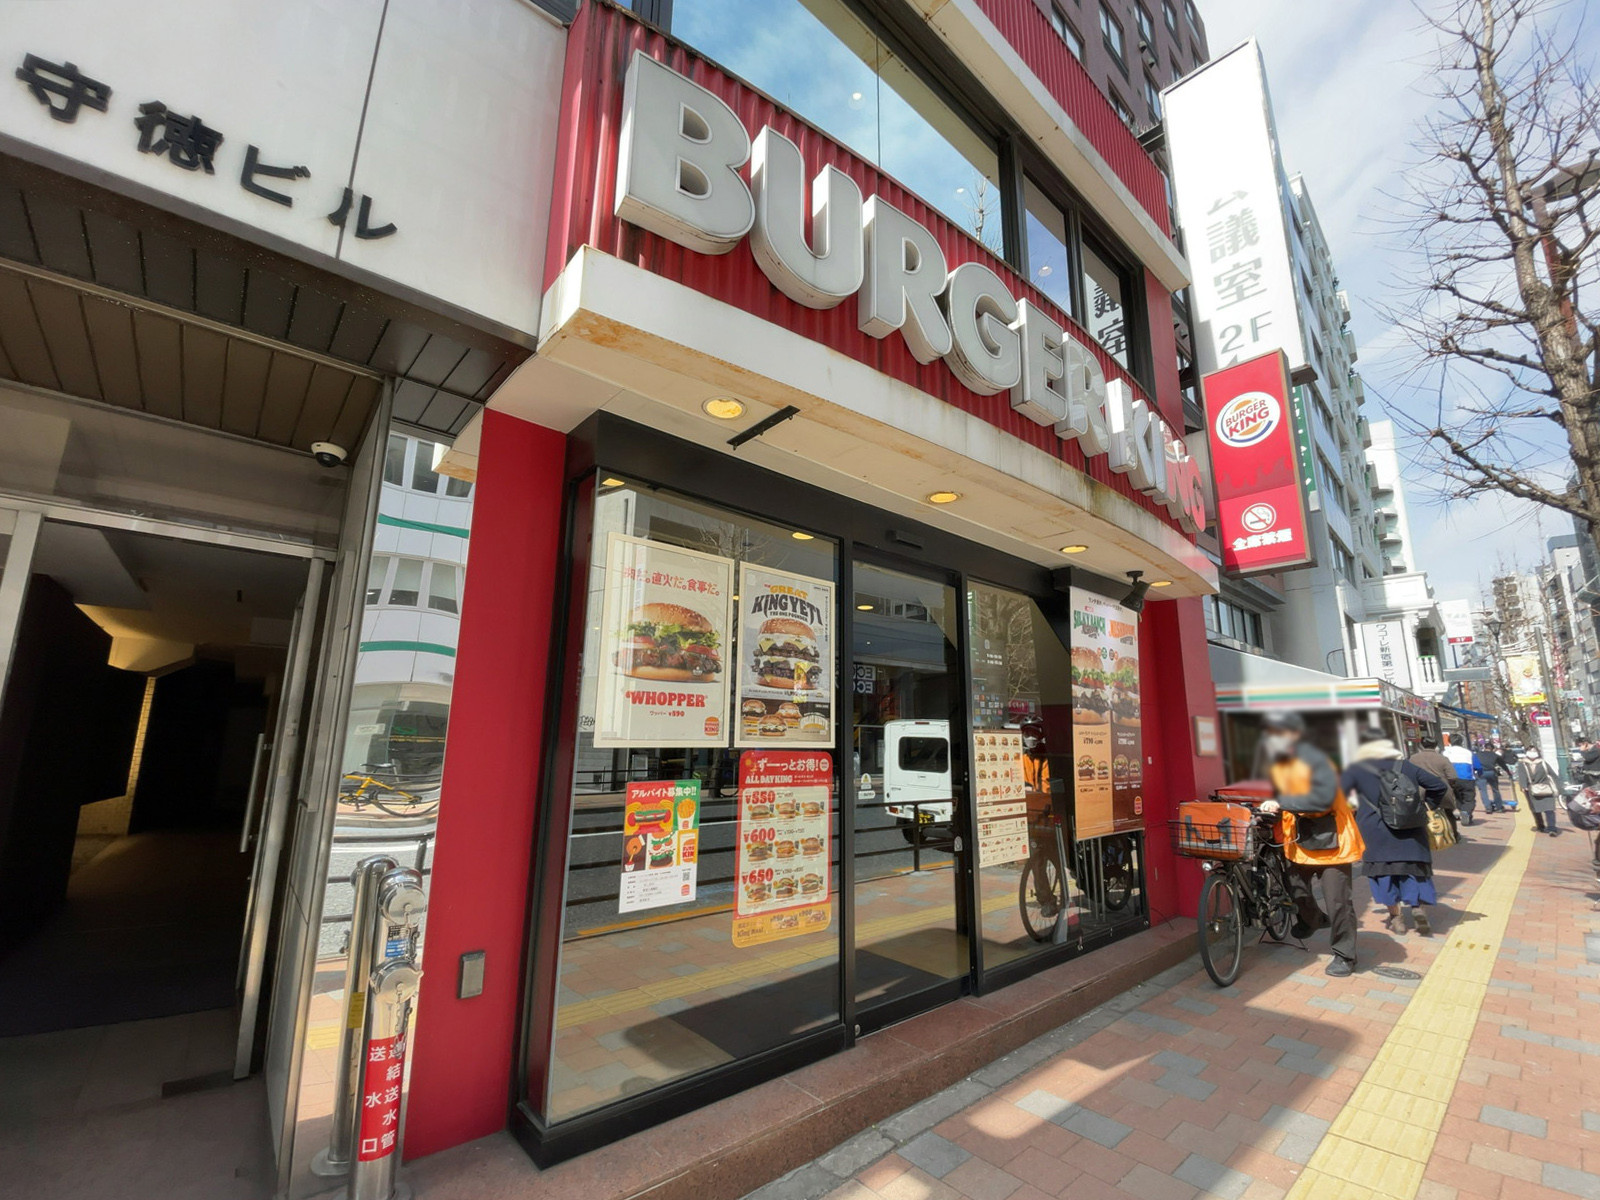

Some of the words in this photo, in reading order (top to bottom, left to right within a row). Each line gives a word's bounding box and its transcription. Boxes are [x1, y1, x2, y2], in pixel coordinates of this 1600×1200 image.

[15, 52, 398, 240] 守徳ビル
[615, 49, 1111, 458] BURGER
[1106, 377, 1206, 533] KING
[1219, 311, 1273, 355] 2F
[1225, 400, 1266, 428] BURGER
[1228, 407, 1270, 439] KING
[770, 585, 808, 599] GREAT
[751, 594, 788, 618] KING
[789, 596, 823, 625] YETI
[625, 690, 706, 707] WHOPPER
[745, 775, 760, 784] ALL
[760, 775, 775, 784] DAY
[775, 775, 792, 783] KING
[745, 790, 776, 804] ¥550
[743, 827, 776, 843] ¥600
[742, 868, 774, 884] ¥650
[361, 1046, 386, 1154] 送水口
